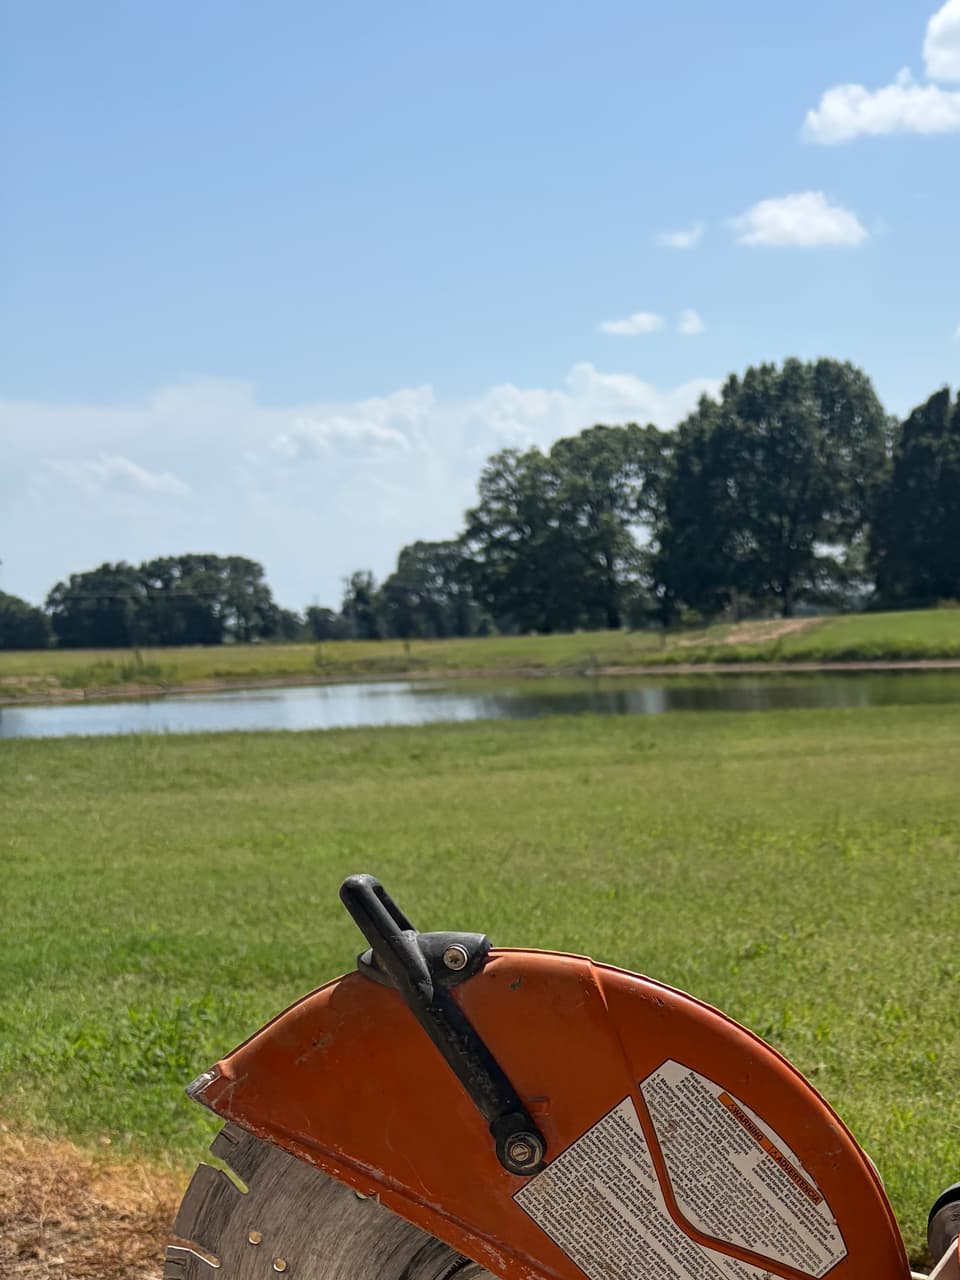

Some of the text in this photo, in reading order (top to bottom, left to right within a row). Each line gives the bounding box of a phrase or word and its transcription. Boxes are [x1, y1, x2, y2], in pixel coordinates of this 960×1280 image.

[679, 1079, 696, 1097] Failure
[698, 1100, 714, 1116] follow
[711, 1114, 726, 1129] these
[723, 1127, 749, 1155] instructions
[730, 1106, 764, 1142] WARNING
[774, 1155, 821, 1204] ADVERTENCIA
